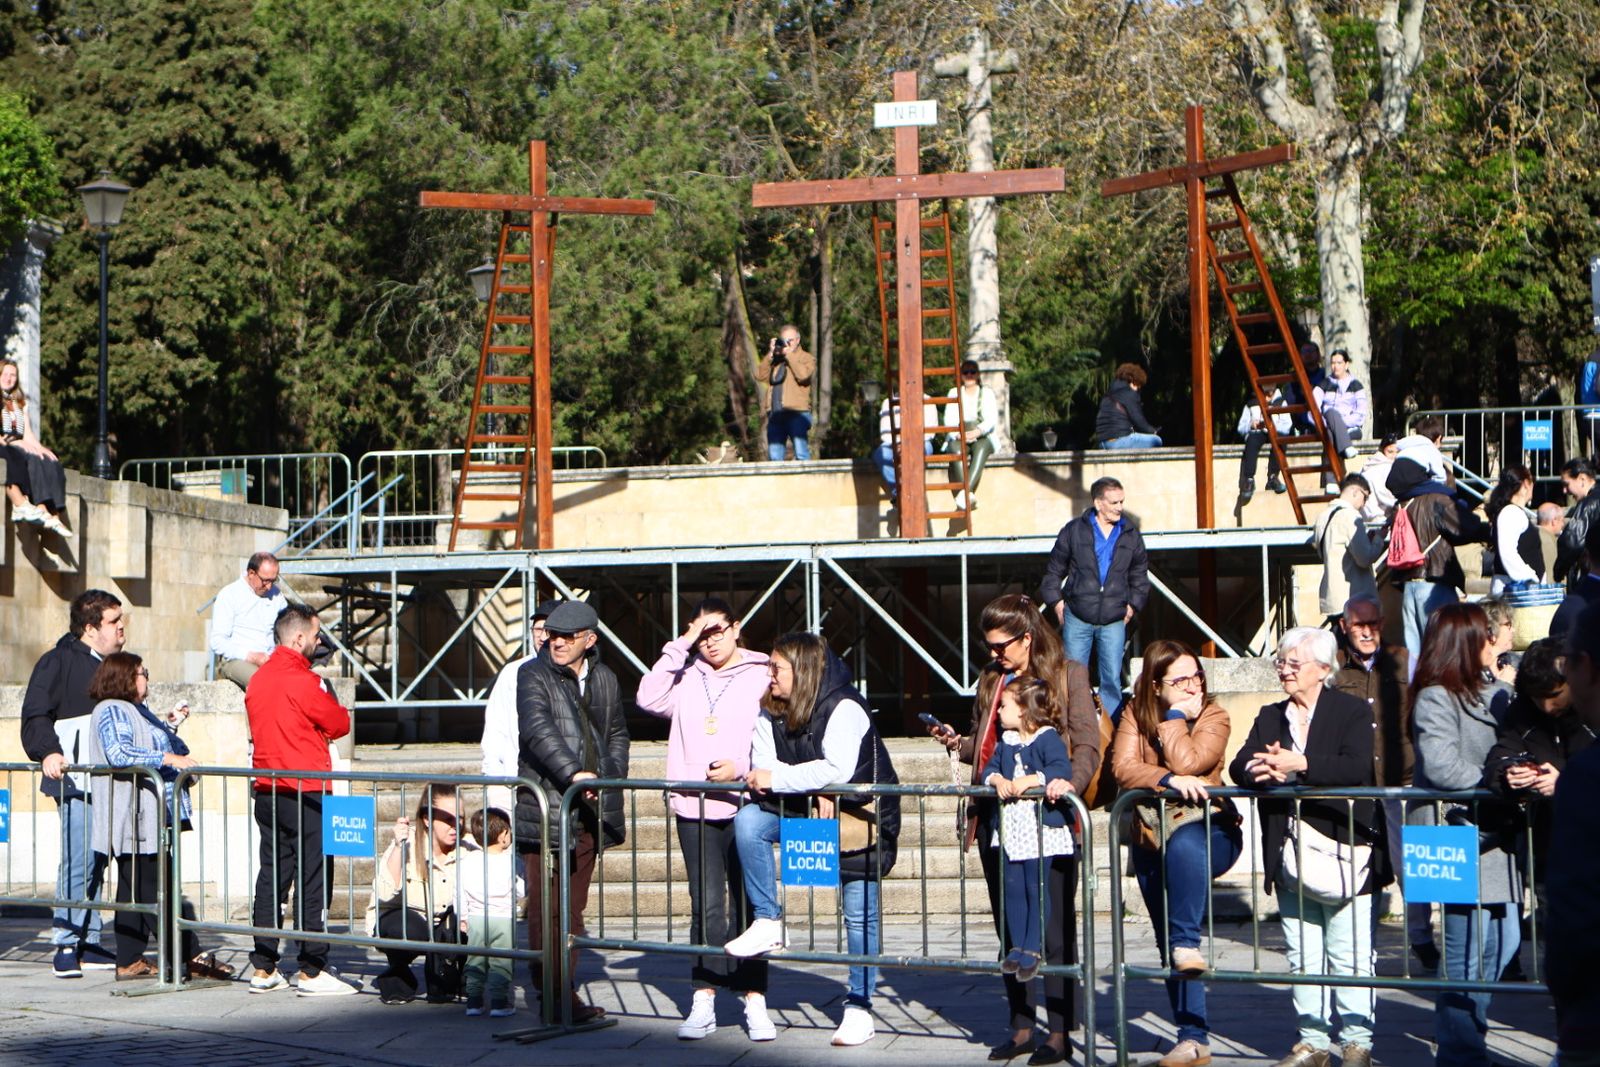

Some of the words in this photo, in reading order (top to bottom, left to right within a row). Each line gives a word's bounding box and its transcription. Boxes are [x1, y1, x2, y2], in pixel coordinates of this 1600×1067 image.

[887, 104, 925, 121] INRI
[332, 815, 367, 830] POLICIA
[334, 830, 365, 844] LOCAL
[786, 840, 835, 855] POLICIA
[1403, 843, 1467, 864] POLICIA
[788, 856, 832, 871] LOCAL
[1406, 861, 1462, 881] LOCAL
